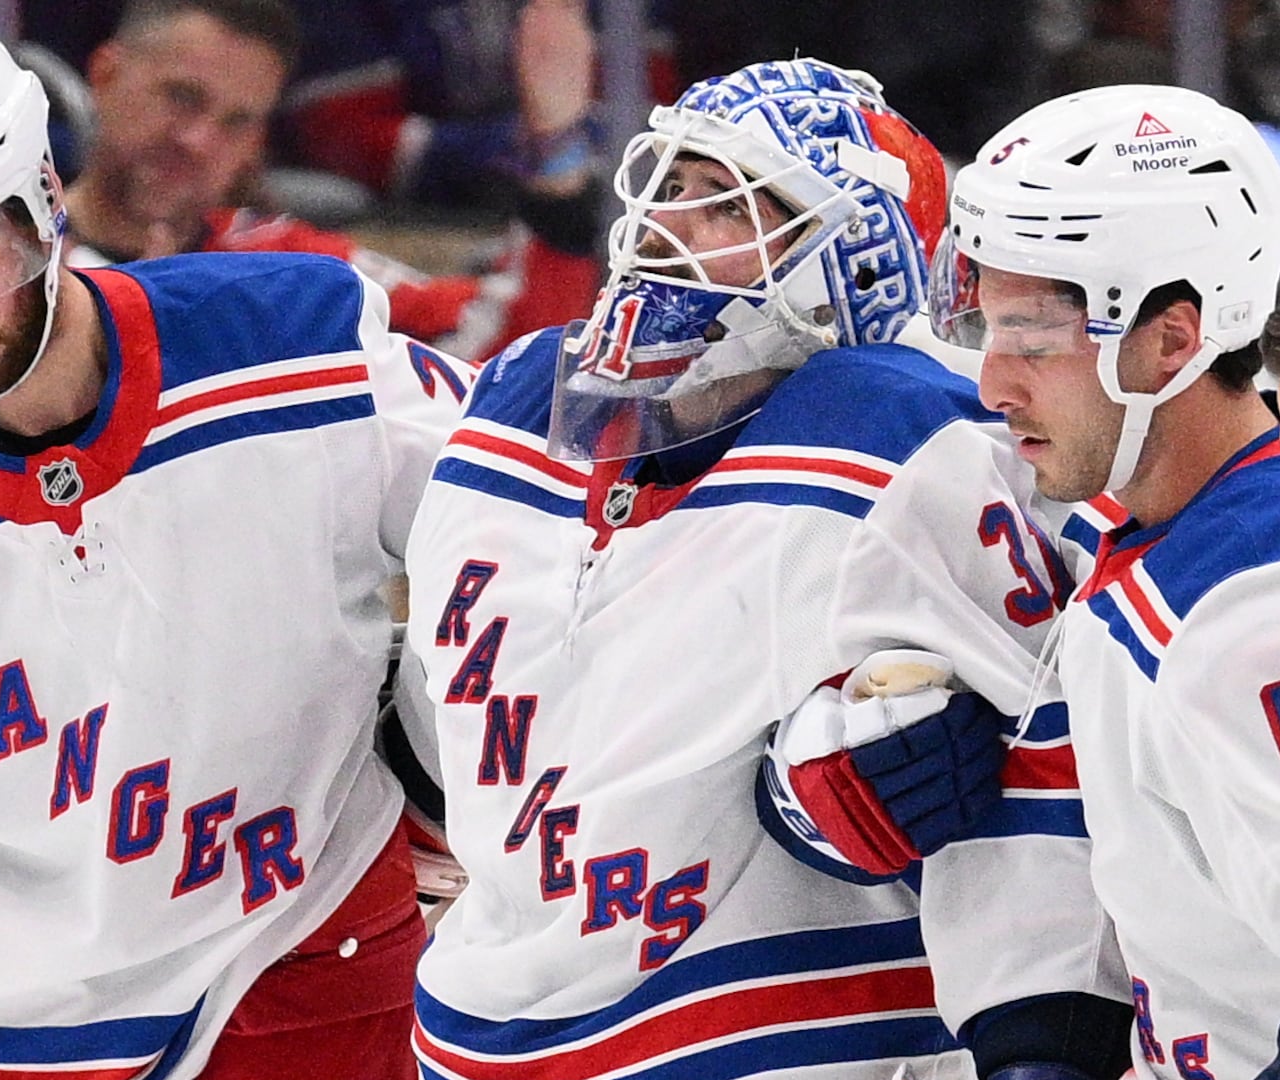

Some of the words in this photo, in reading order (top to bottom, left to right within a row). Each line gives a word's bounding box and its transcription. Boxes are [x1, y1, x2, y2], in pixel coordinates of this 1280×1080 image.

[990, 136, 1031, 166] 5
[1115, 136, 1198, 159] Benjamin
[1131, 155, 1189, 173] Moore
[50, 468, 72, 500] NHL
[977, 500, 1076, 628] 31
